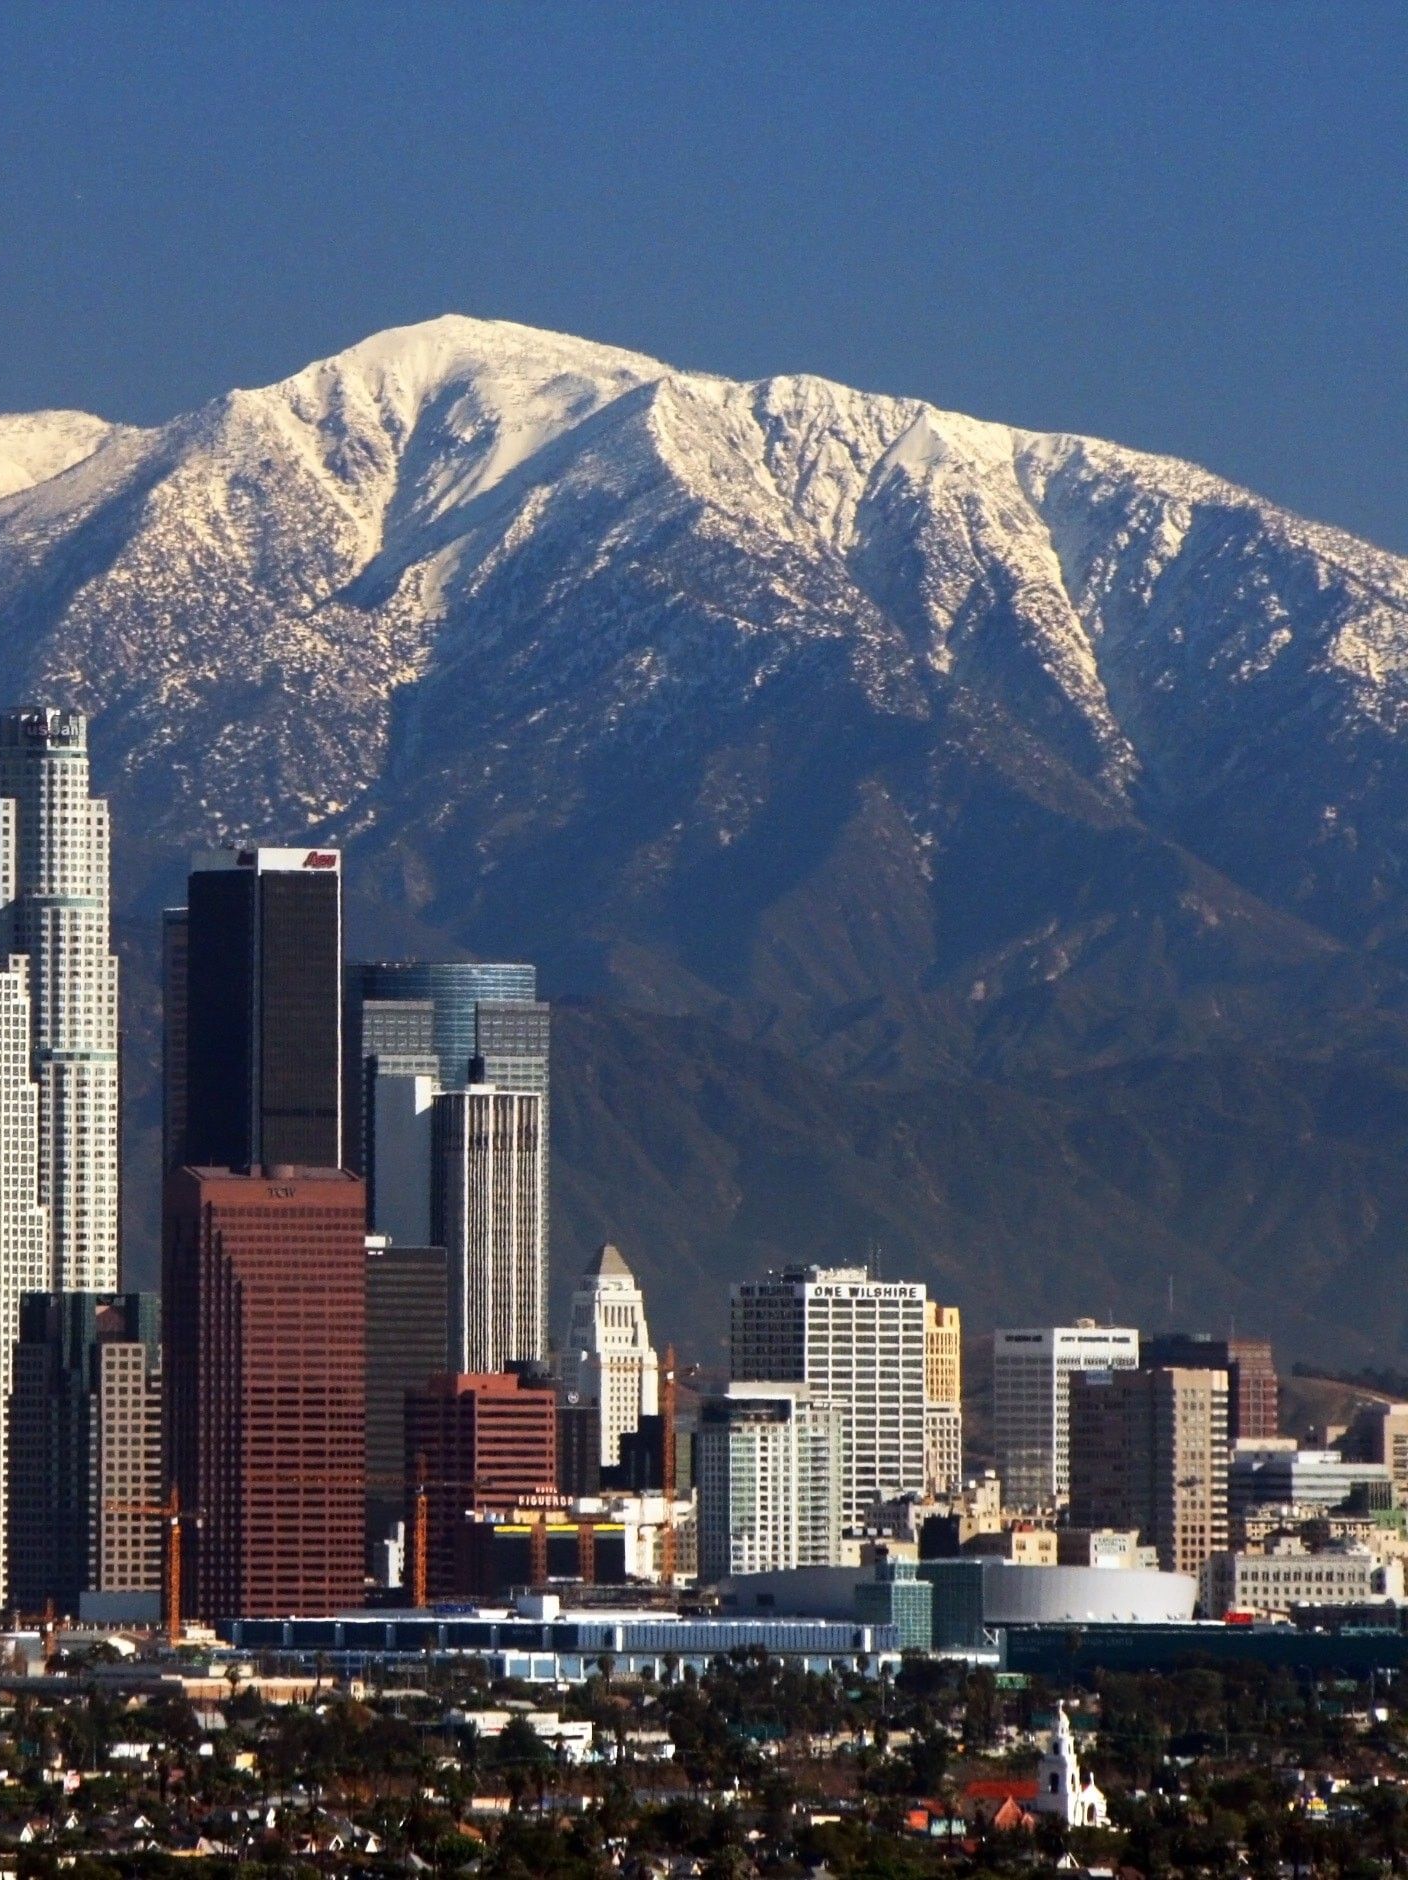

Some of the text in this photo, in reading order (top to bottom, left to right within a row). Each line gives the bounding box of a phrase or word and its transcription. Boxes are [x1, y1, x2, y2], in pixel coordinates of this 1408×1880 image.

[814, 1286, 918, 1298] ONE WILSHIRE
[518, 1495, 574, 1506] FIGUEROA
